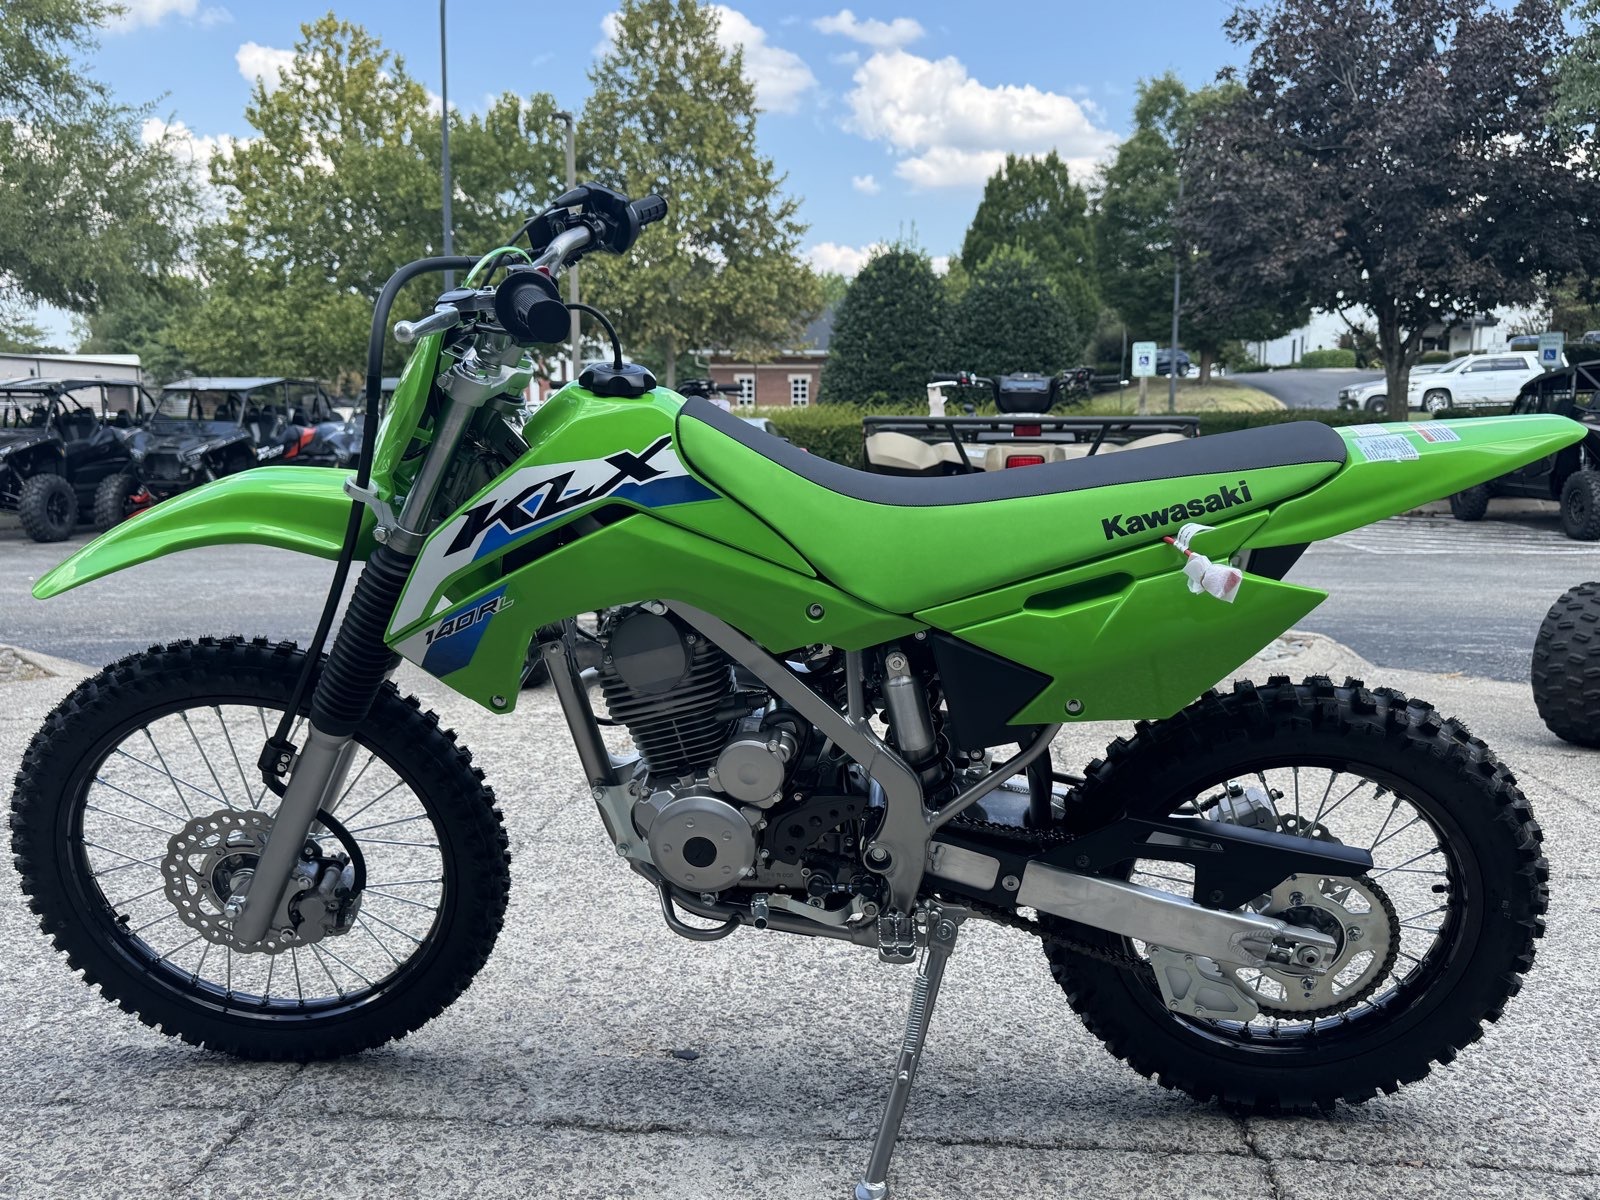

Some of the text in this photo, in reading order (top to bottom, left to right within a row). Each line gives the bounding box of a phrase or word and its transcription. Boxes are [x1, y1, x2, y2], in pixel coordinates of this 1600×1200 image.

[443, 435, 673, 558] KLX
[1101, 480, 1252, 541] Kawasaki
[425, 596, 514, 646] 140RL
